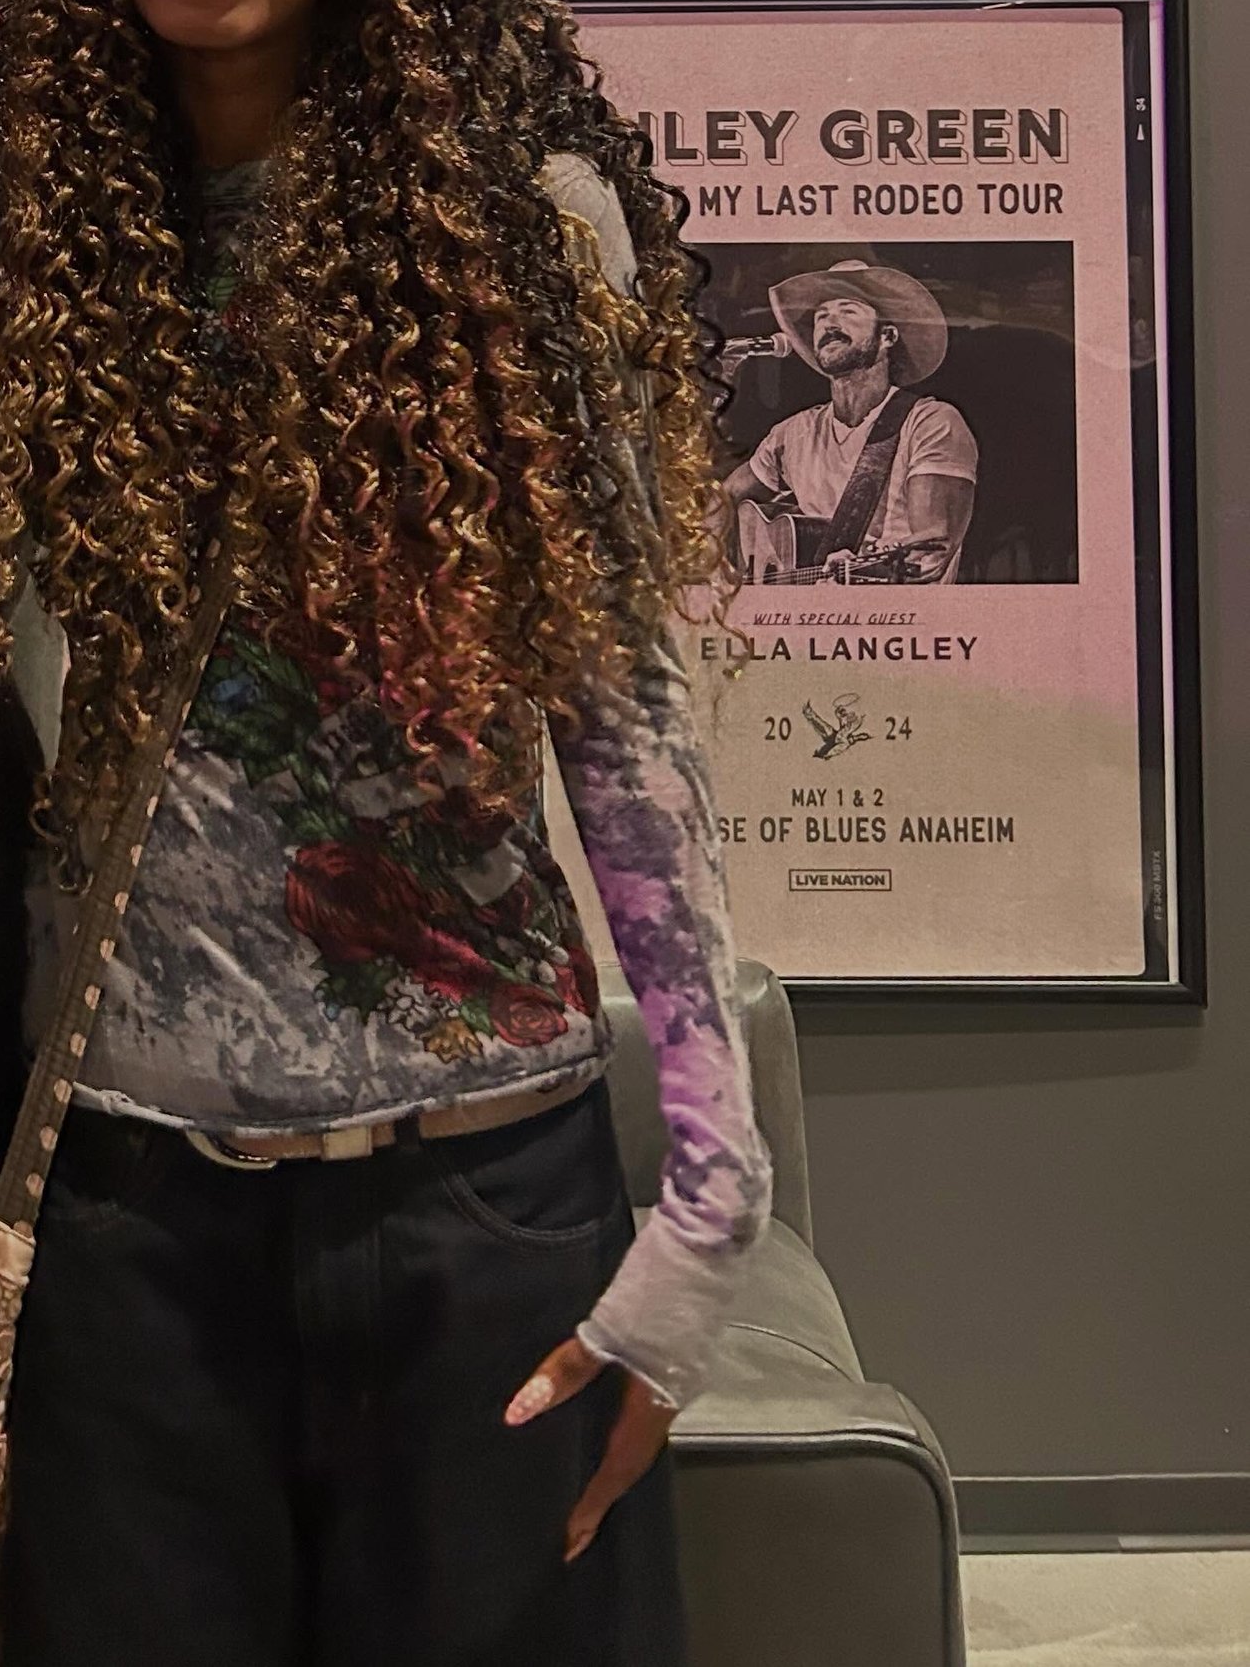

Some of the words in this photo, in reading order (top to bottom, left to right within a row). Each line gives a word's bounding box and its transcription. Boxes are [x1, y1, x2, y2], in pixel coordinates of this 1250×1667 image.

[819, 108, 1070, 167] GREEN
[700, 185, 743, 216] MY
[756, 184, 839, 216] LAST
[853, 183, 963, 216] RODEO
[976, 183, 1063, 215] TOUR
[752, 613, 792, 626] WITH
[799, 612, 862, 626] SPECIAL
[867, 612, 918, 625] GUEST
[699, 636, 793, 662] ELLA
[808, 636, 978, 662] LANGLEY
[763, 715, 793, 742] 20
[884, 715, 913, 742] 24
[791, 788, 827, 807] MAY
[836, 788, 844, 807] 1
[852, 789, 864, 807] &
[873, 788, 885, 806] 2
[759, 816, 793, 843] OF
[805, 816, 887, 843] BLUES
[899, 816, 1015, 843] ANAHEIM
[795, 874, 829, 886] LIVE
[831, 873, 886, 886] NATION
